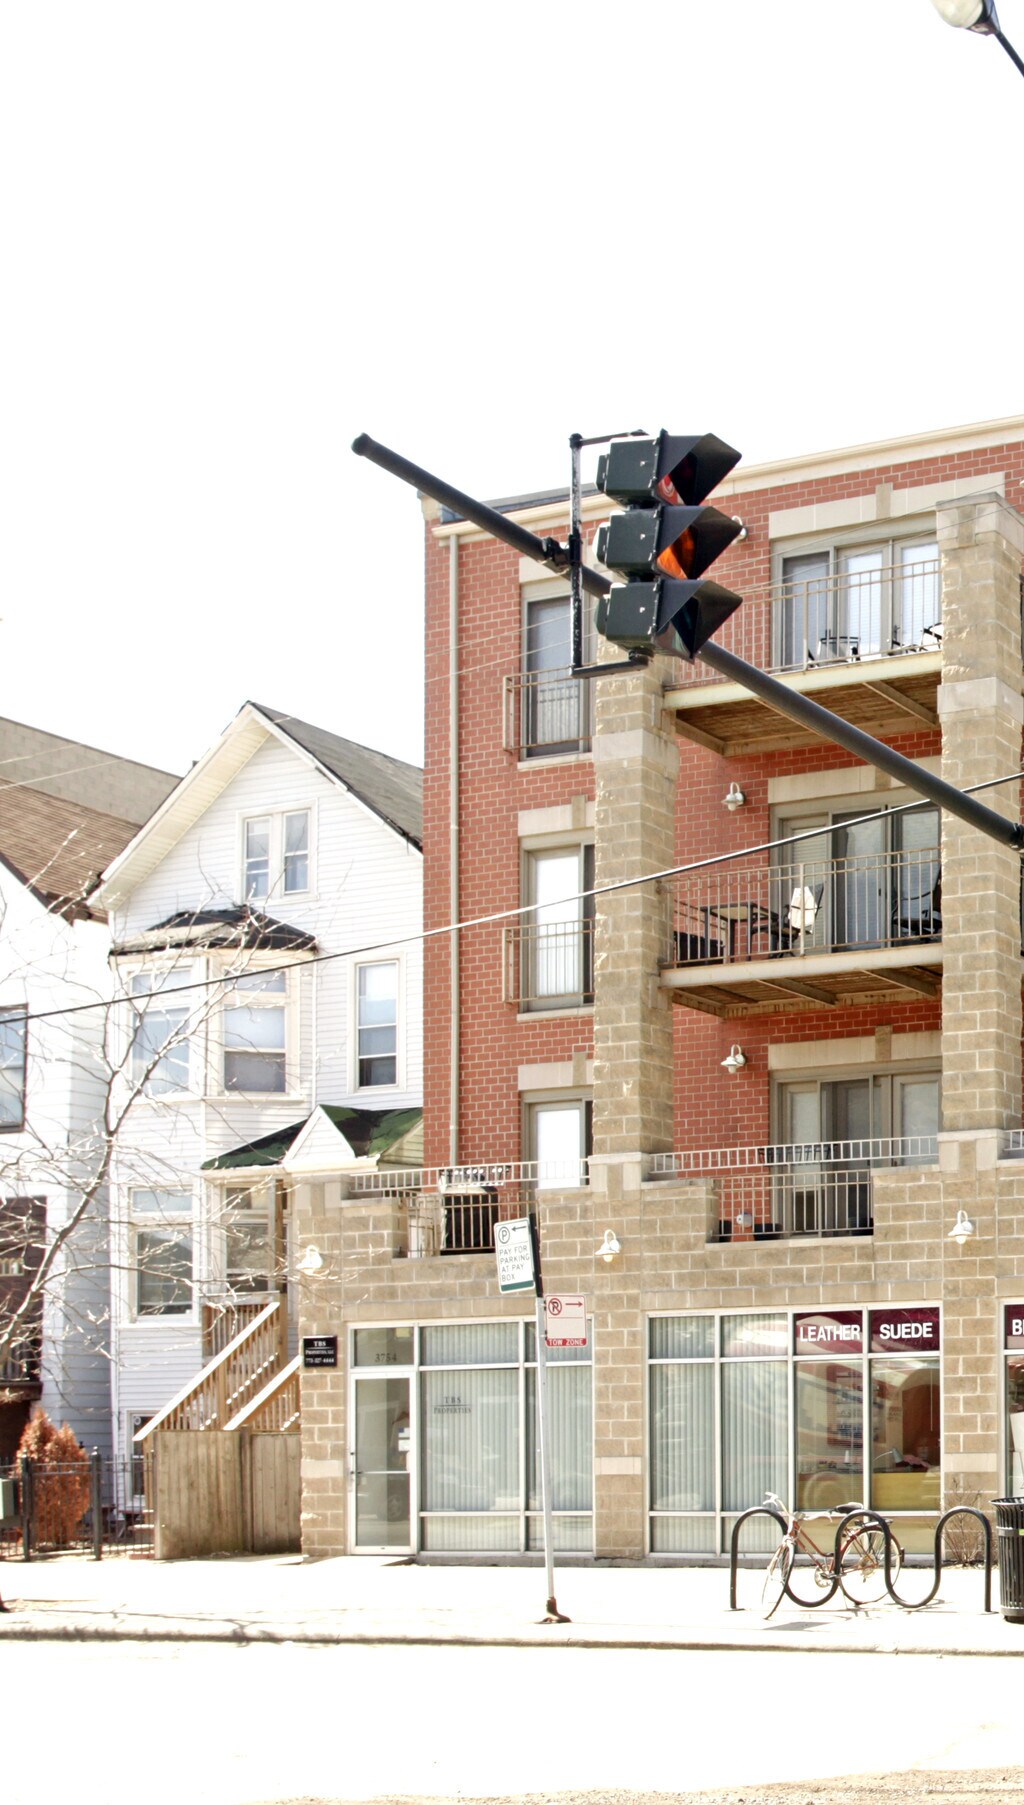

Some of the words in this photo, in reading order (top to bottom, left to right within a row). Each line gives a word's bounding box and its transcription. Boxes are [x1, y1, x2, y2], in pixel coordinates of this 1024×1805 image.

[499, 1248, 512, 1256] PAY
[514, 1244, 528, 1254] FOR
[500, 1253, 530, 1264] PARKING
[501, 1265, 510, 1273] AT
[501, 1273, 515, 1282] BOX
[800, 1324, 861, 1342] LEATHER
[879, 1322, 933, 1340] SUEDE
[549, 1338, 563, 1346] TOW
[566, 1338, 584, 1346] ZONE
[374, 1353, 397, 1363] 3754
[433, 1406, 472, 1414] PROPERTIES
